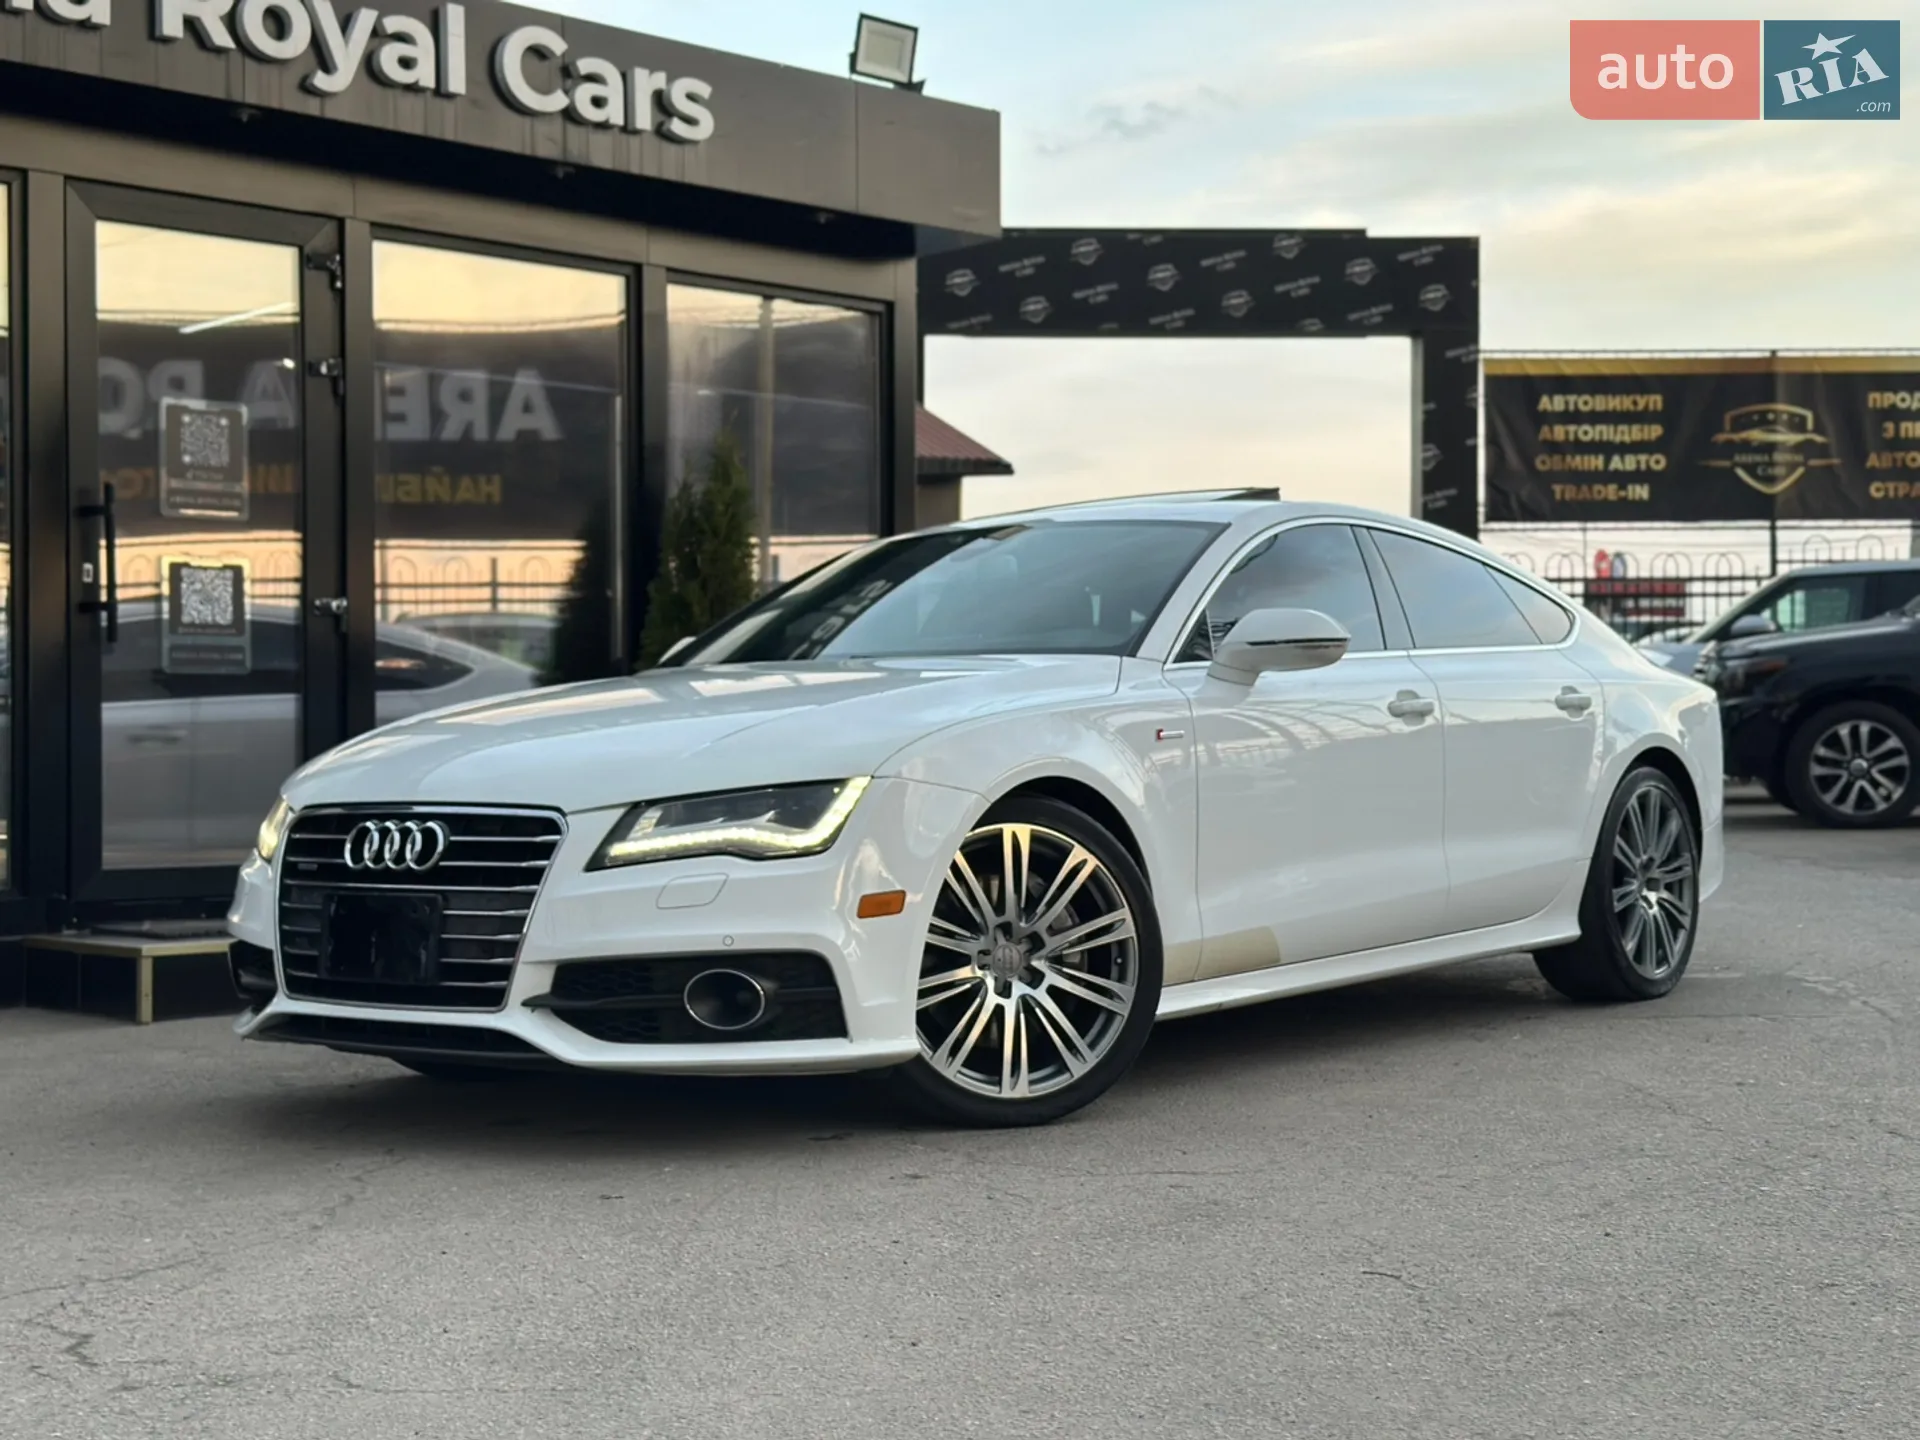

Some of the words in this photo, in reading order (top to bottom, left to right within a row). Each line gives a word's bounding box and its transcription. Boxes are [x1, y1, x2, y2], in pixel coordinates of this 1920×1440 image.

[494, 25, 715, 141] Cars
[1537, 394, 1664, 412] АВТОВИКУП
[1538, 424, 1664, 443] АВТОПІДБІР
[1535, 454, 1604, 471] ОБМІН
[1608, 454, 1667, 471] АВТО
[1551, 484, 1650, 501] TRADE-IN
